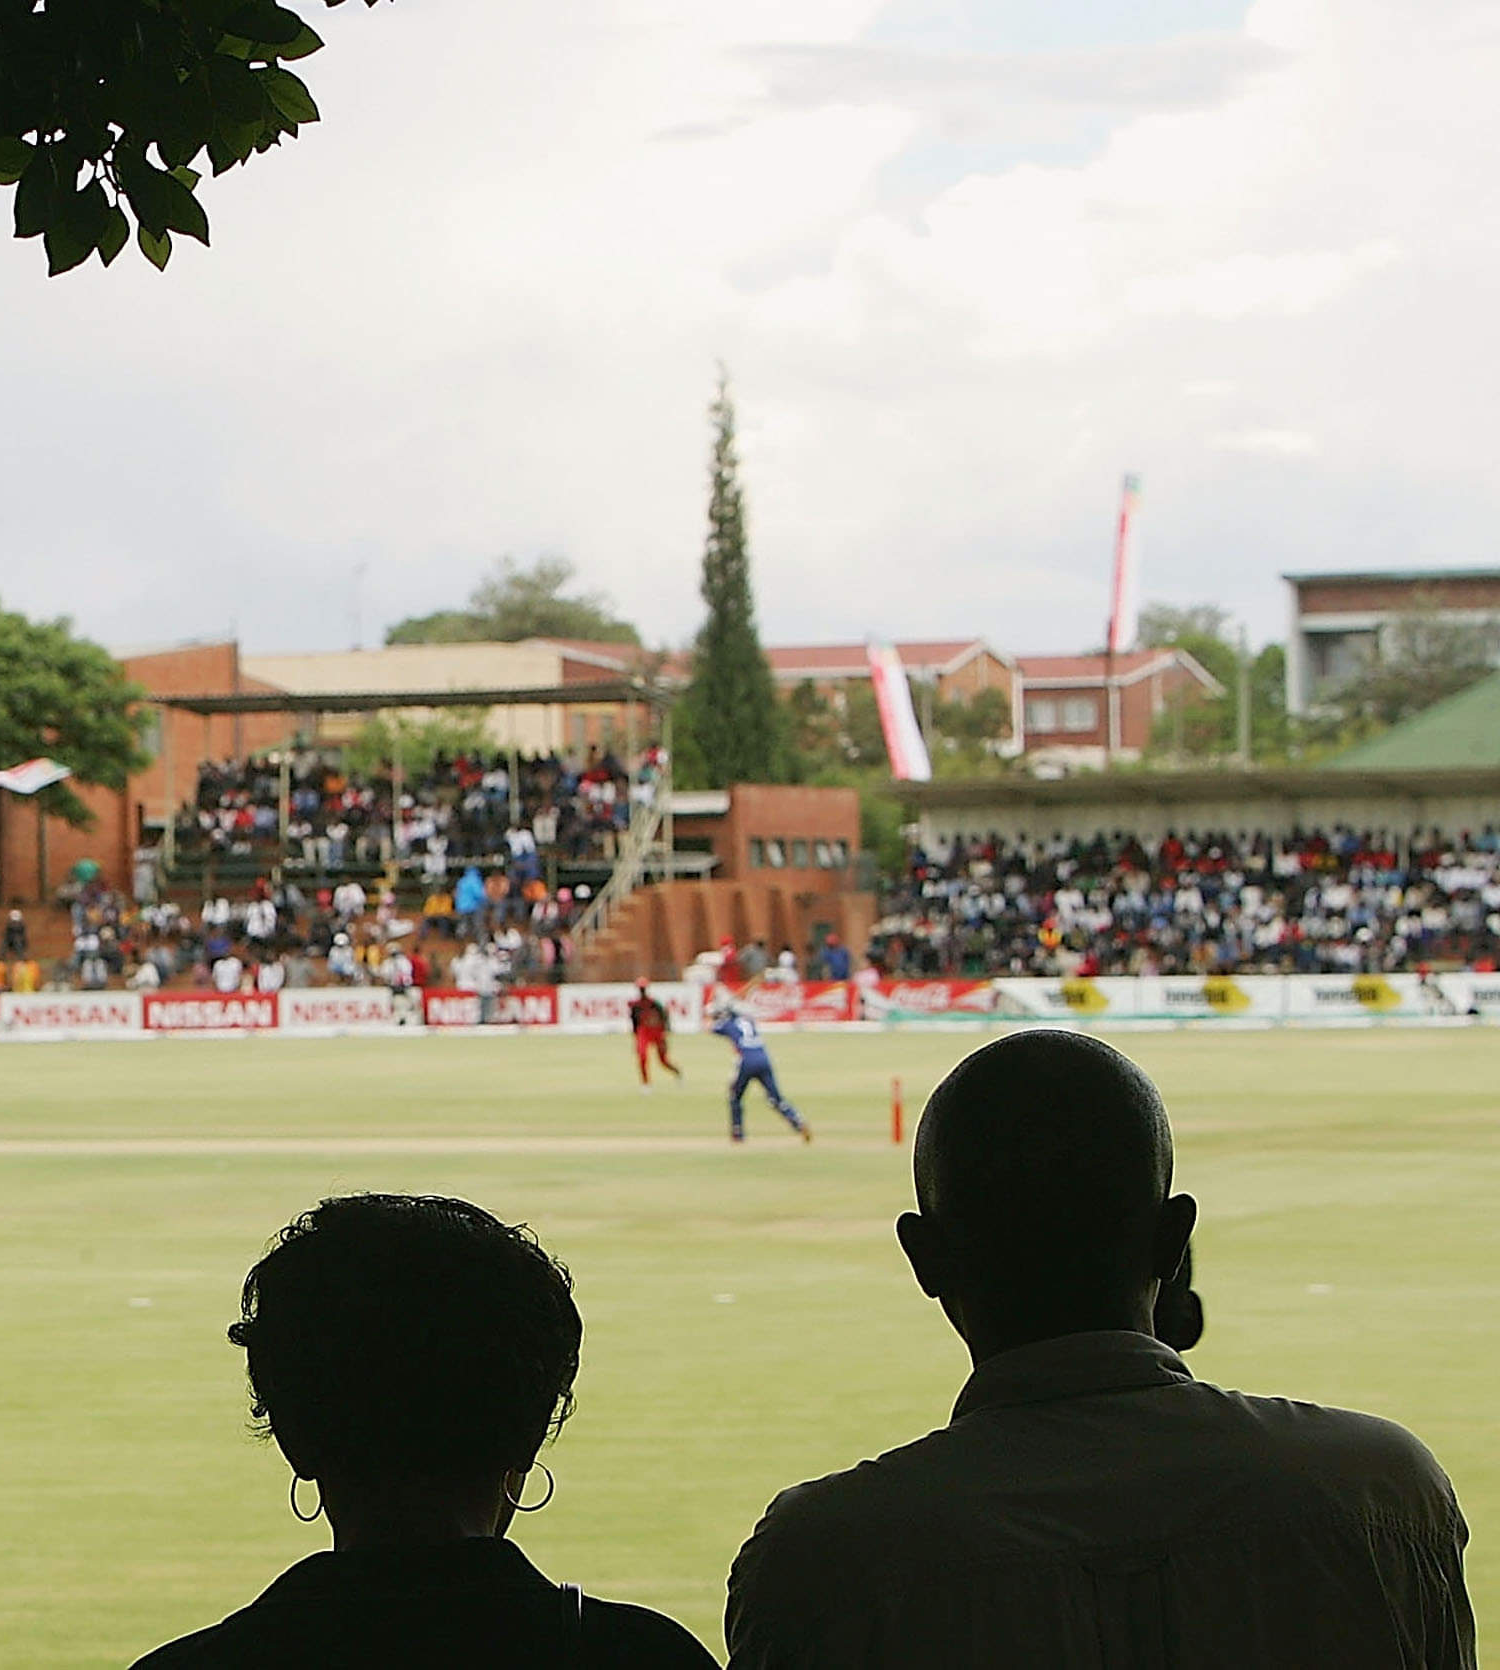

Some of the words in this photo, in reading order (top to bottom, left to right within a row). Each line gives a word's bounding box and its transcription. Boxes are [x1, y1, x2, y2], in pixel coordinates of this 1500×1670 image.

[13, 1004, 129, 1027] NISSAN
[150, 1001, 272, 1027] NISSAN
[293, 1000, 396, 1022] NISSA
[427, 997, 552, 1023] NISAN
[569, 999, 688, 1018] NISN
